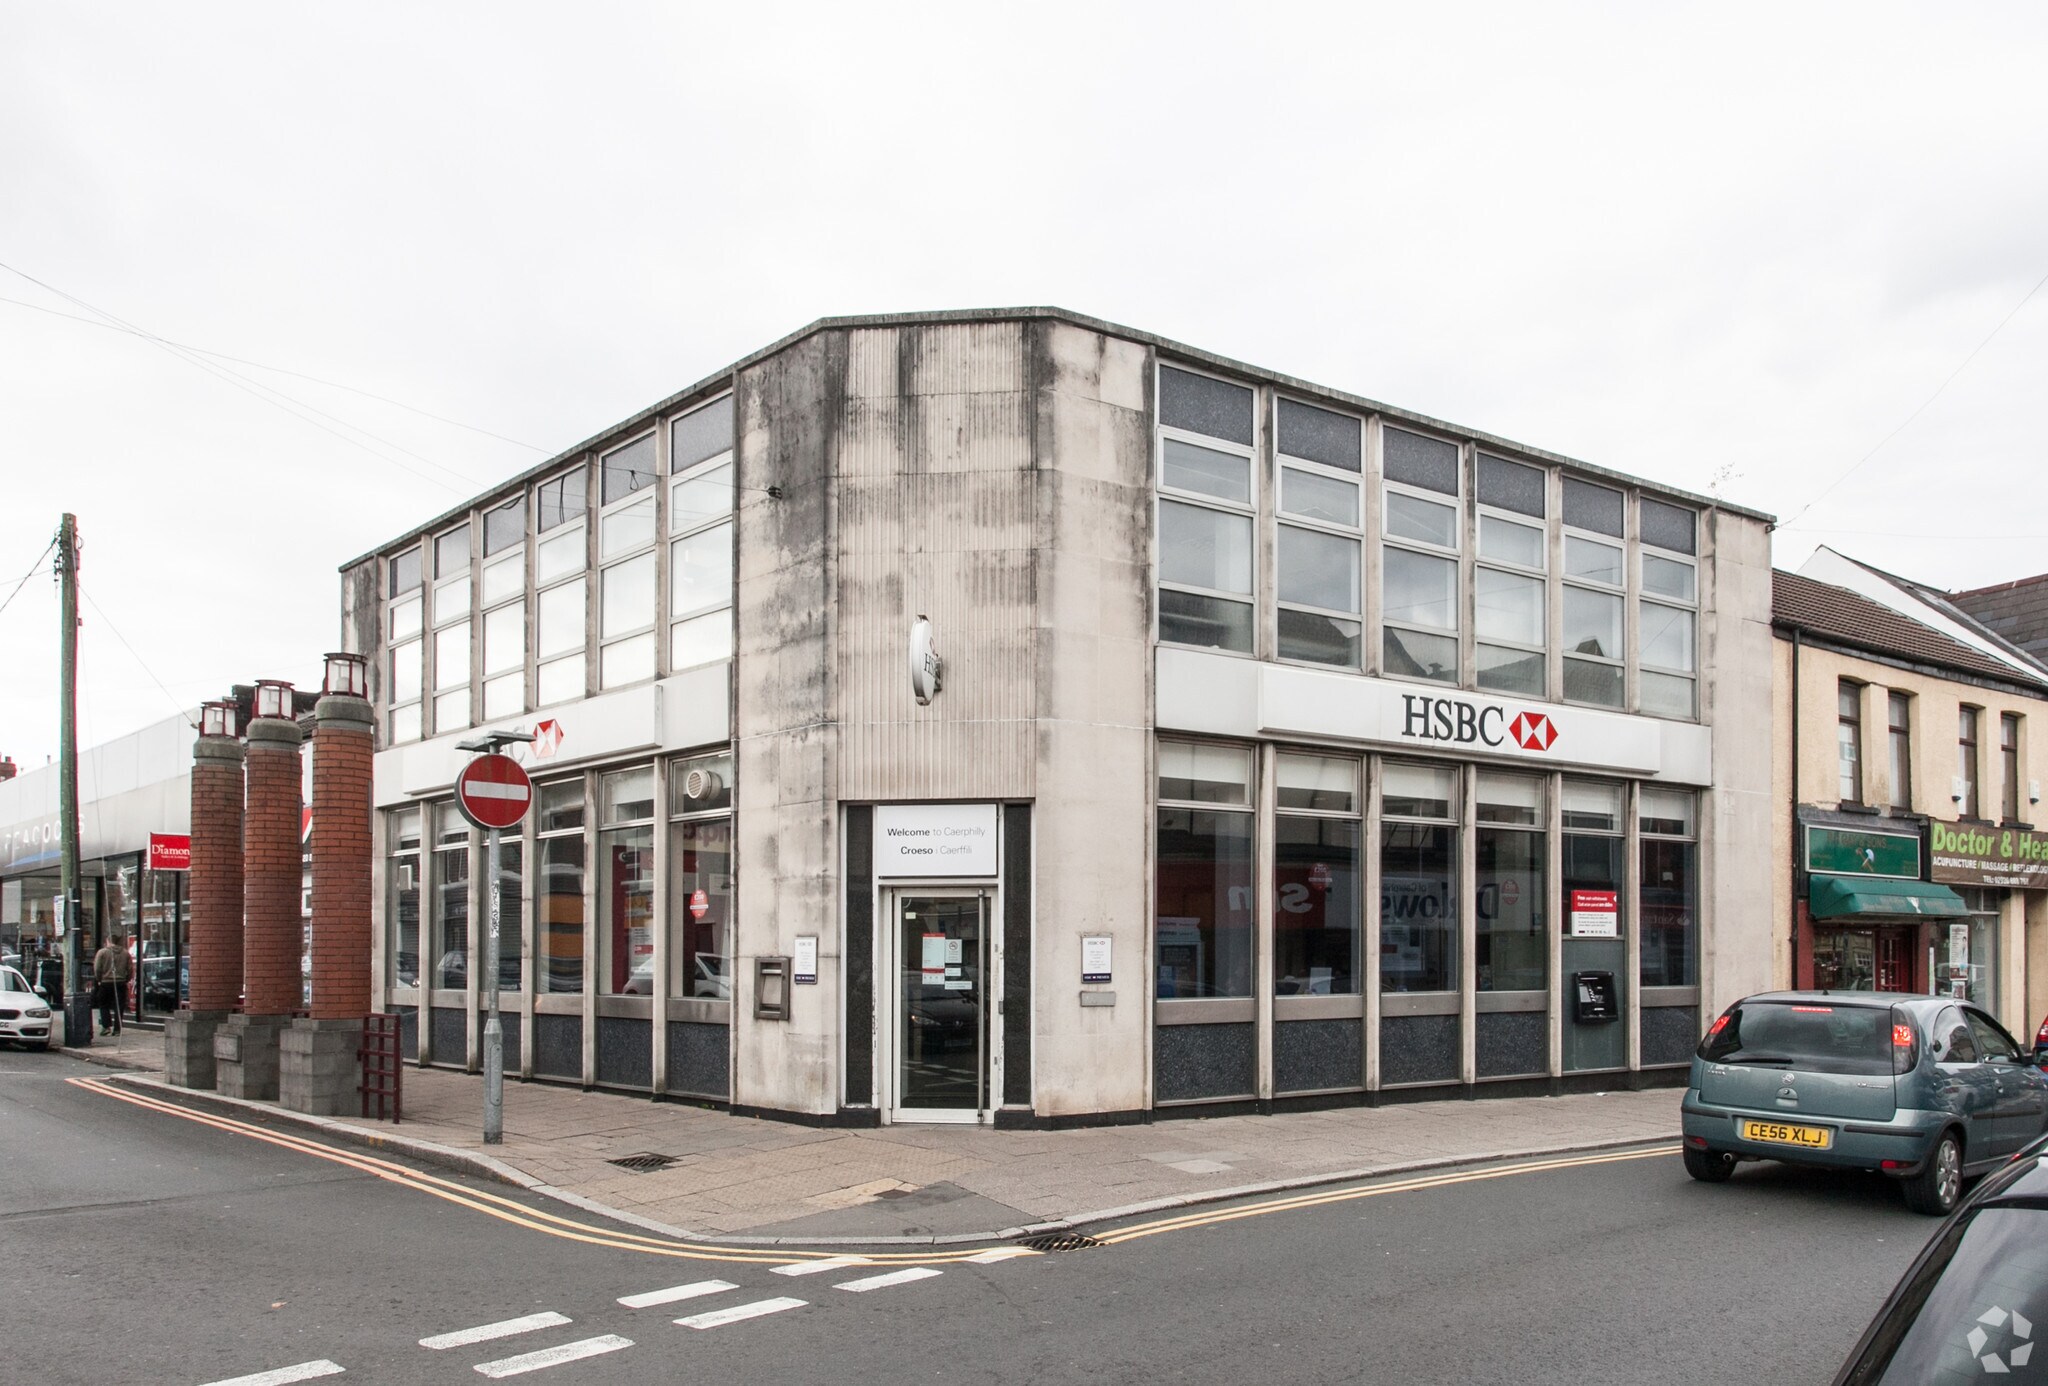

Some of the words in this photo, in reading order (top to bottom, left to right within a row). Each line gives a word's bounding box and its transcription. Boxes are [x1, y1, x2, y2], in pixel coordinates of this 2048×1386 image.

[1402, 694, 1504, 746] HSBC
[4, 813, 85, 852] PEACOCS
[887, 828, 930, 837] Welcome
[932, 827, 942, 836] to
[943, 826, 985, 837] Caerphilly
[1932, 822, 1995, 856] Doctor
[2000, 830, 2013, 858] &
[900, 846, 934, 855] Croeso
[939, 845, 972, 855] Caerffili
[1932, 856, 1977, 869] ACUPUNCTURE
[1981, 860, 2009, 872] MASSAGE
[1750, 1123, 1787, 1140] CE56
[1791, 1128, 1822, 1144] XLJ
